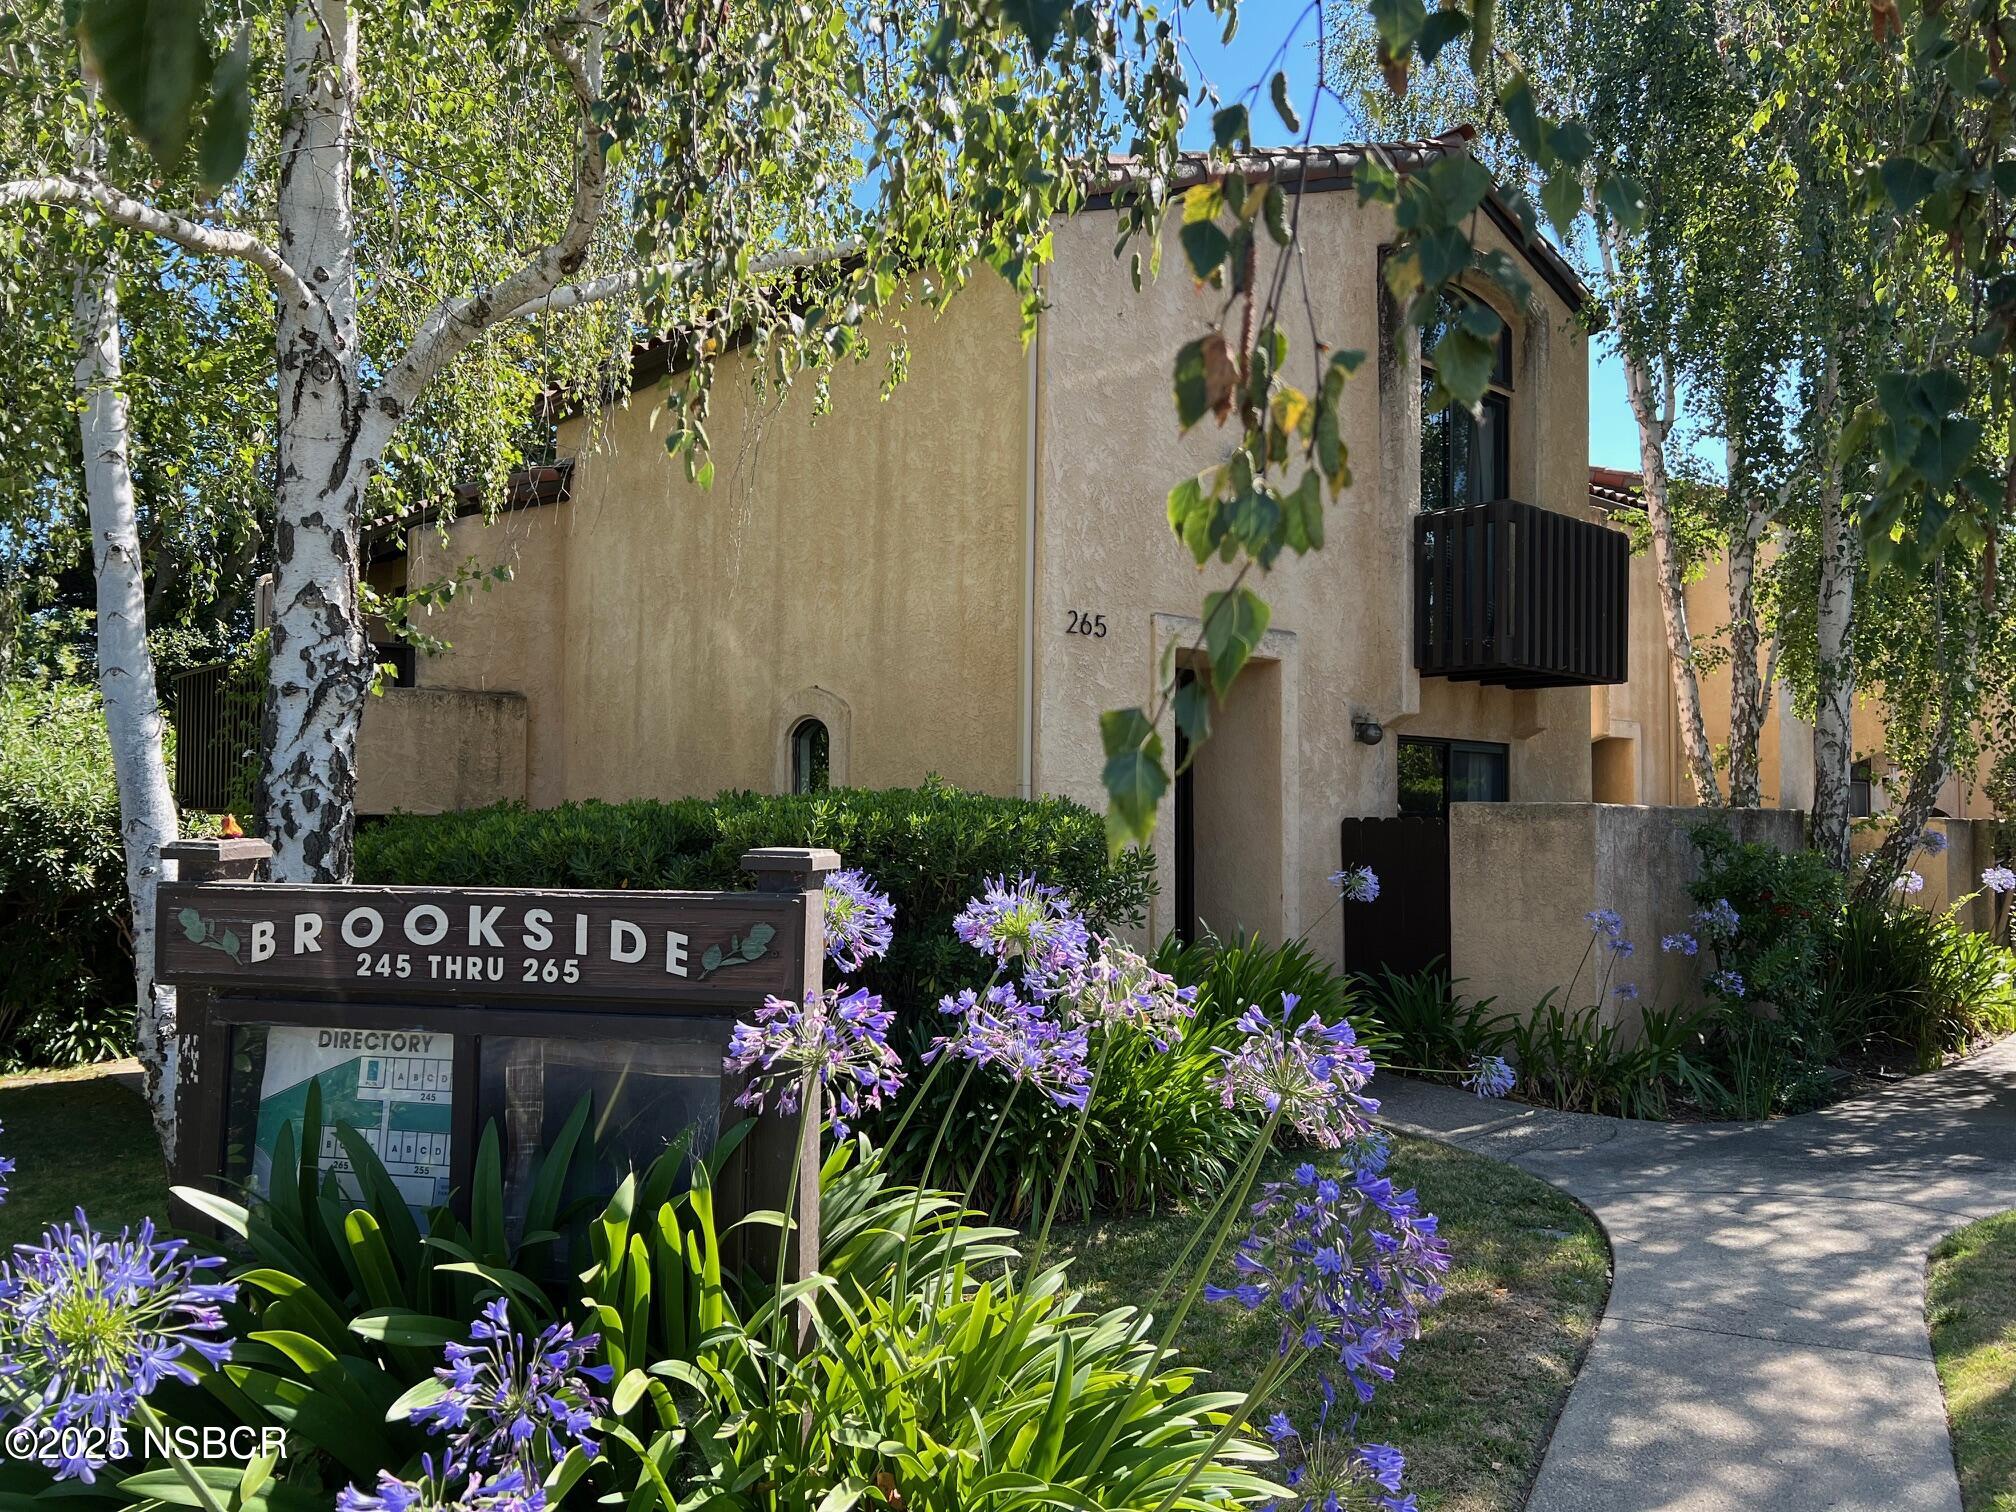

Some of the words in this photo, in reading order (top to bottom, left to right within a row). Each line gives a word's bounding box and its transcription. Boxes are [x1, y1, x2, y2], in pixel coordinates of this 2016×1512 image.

[1065, 610, 1107, 638] 265
[251, 904, 688, 978] BROOKSIDE
[356, 953, 412, 978] 245
[428, 956, 504, 981] THRU
[522, 959, 580, 984] 265
[318, 1030, 434, 1053] DIRECTORY
[427, 1074, 434, 1082] C
[442, 1075, 448, 1083] D
[420, 1093, 436, 1101] 245
[326, 1141, 332, 1149] B
[391, 1145, 398, 1153] A
[406, 1145, 412, 1154] B
[420, 1146, 427, 1154] C
[435, 1147, 441, 1155] D
[333, 1161, 349, 1170] 265
[414, 1166, 430, 1175] 255
